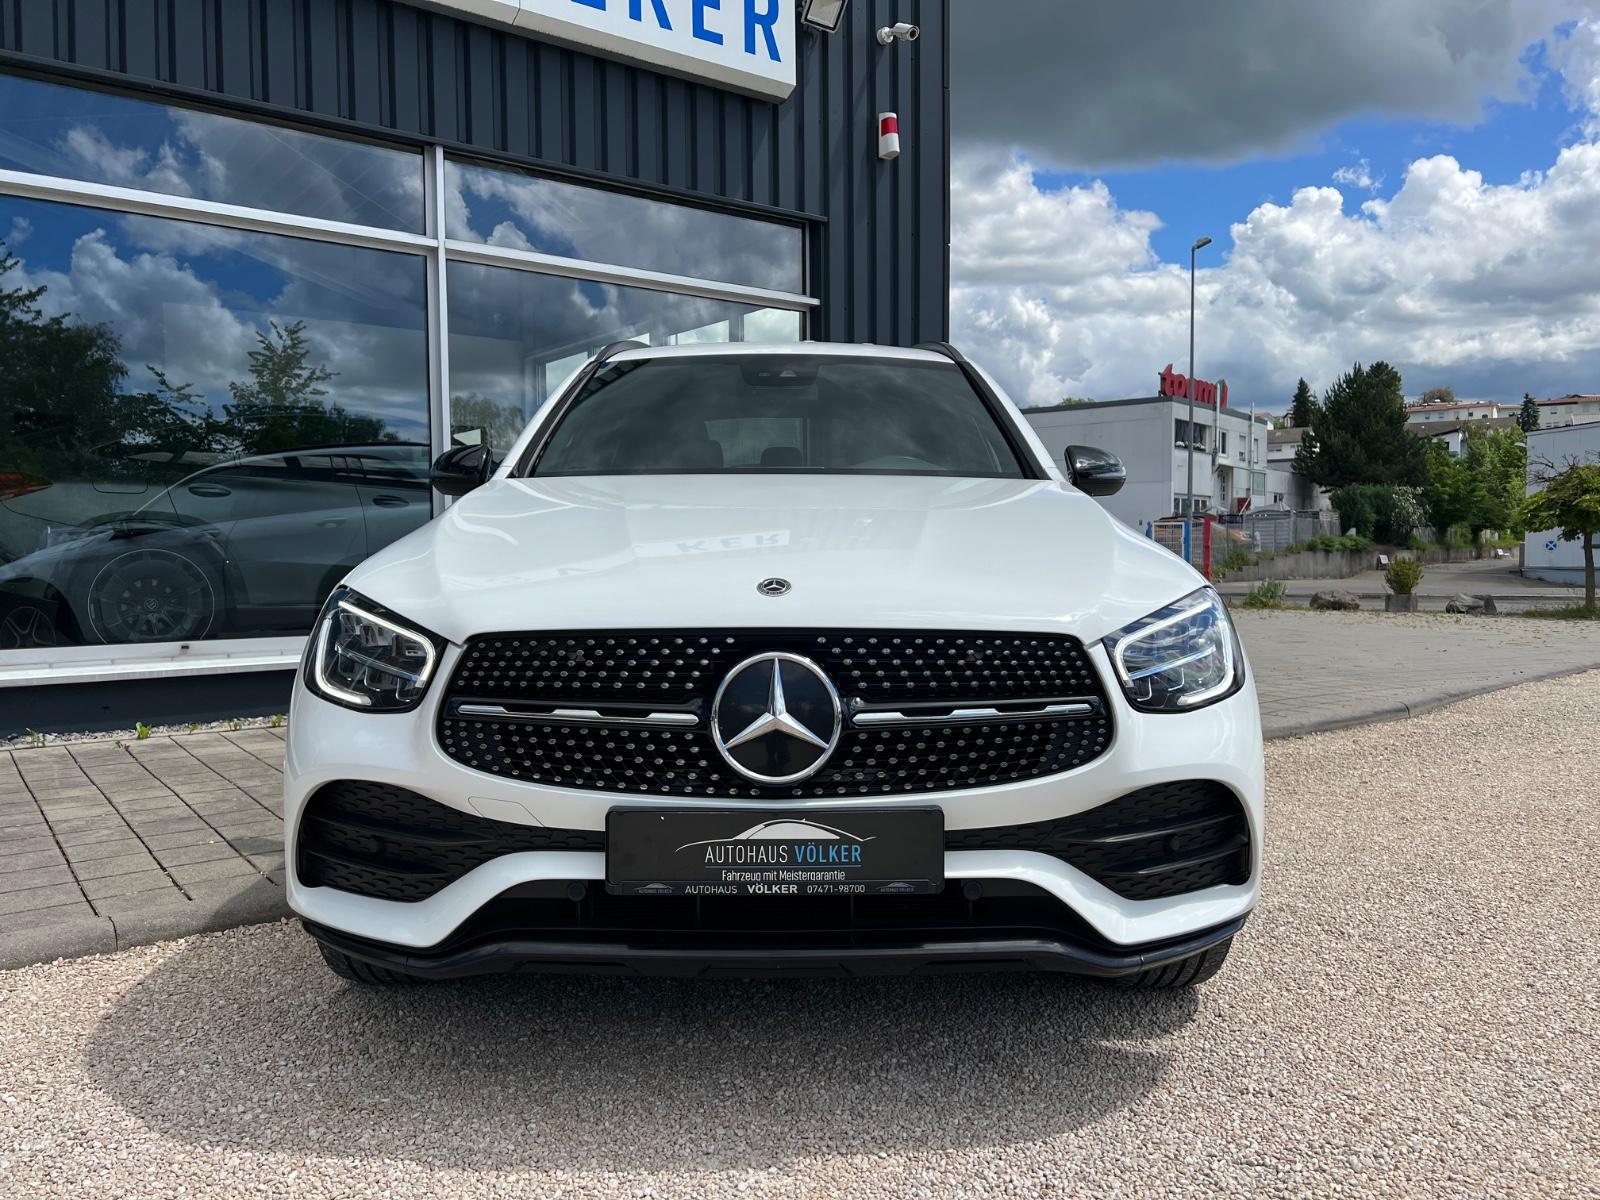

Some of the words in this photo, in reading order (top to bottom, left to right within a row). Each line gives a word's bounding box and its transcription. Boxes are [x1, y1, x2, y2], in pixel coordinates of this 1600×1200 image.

[704, 845, 788, 863] AUTOHAUS
[794, 842, 861, 863] VÖLKER
[722, 870, 761, 881] Fahrzeug
[763, 870, 777, 881] mit
[779, 870, 846, 881] Meistergarantie
[685, 885, 738, 894] AUTOHAUS
[747, 883, 798, 894] VÖLKER
[807, 884, 866, 893] 07471-98700
